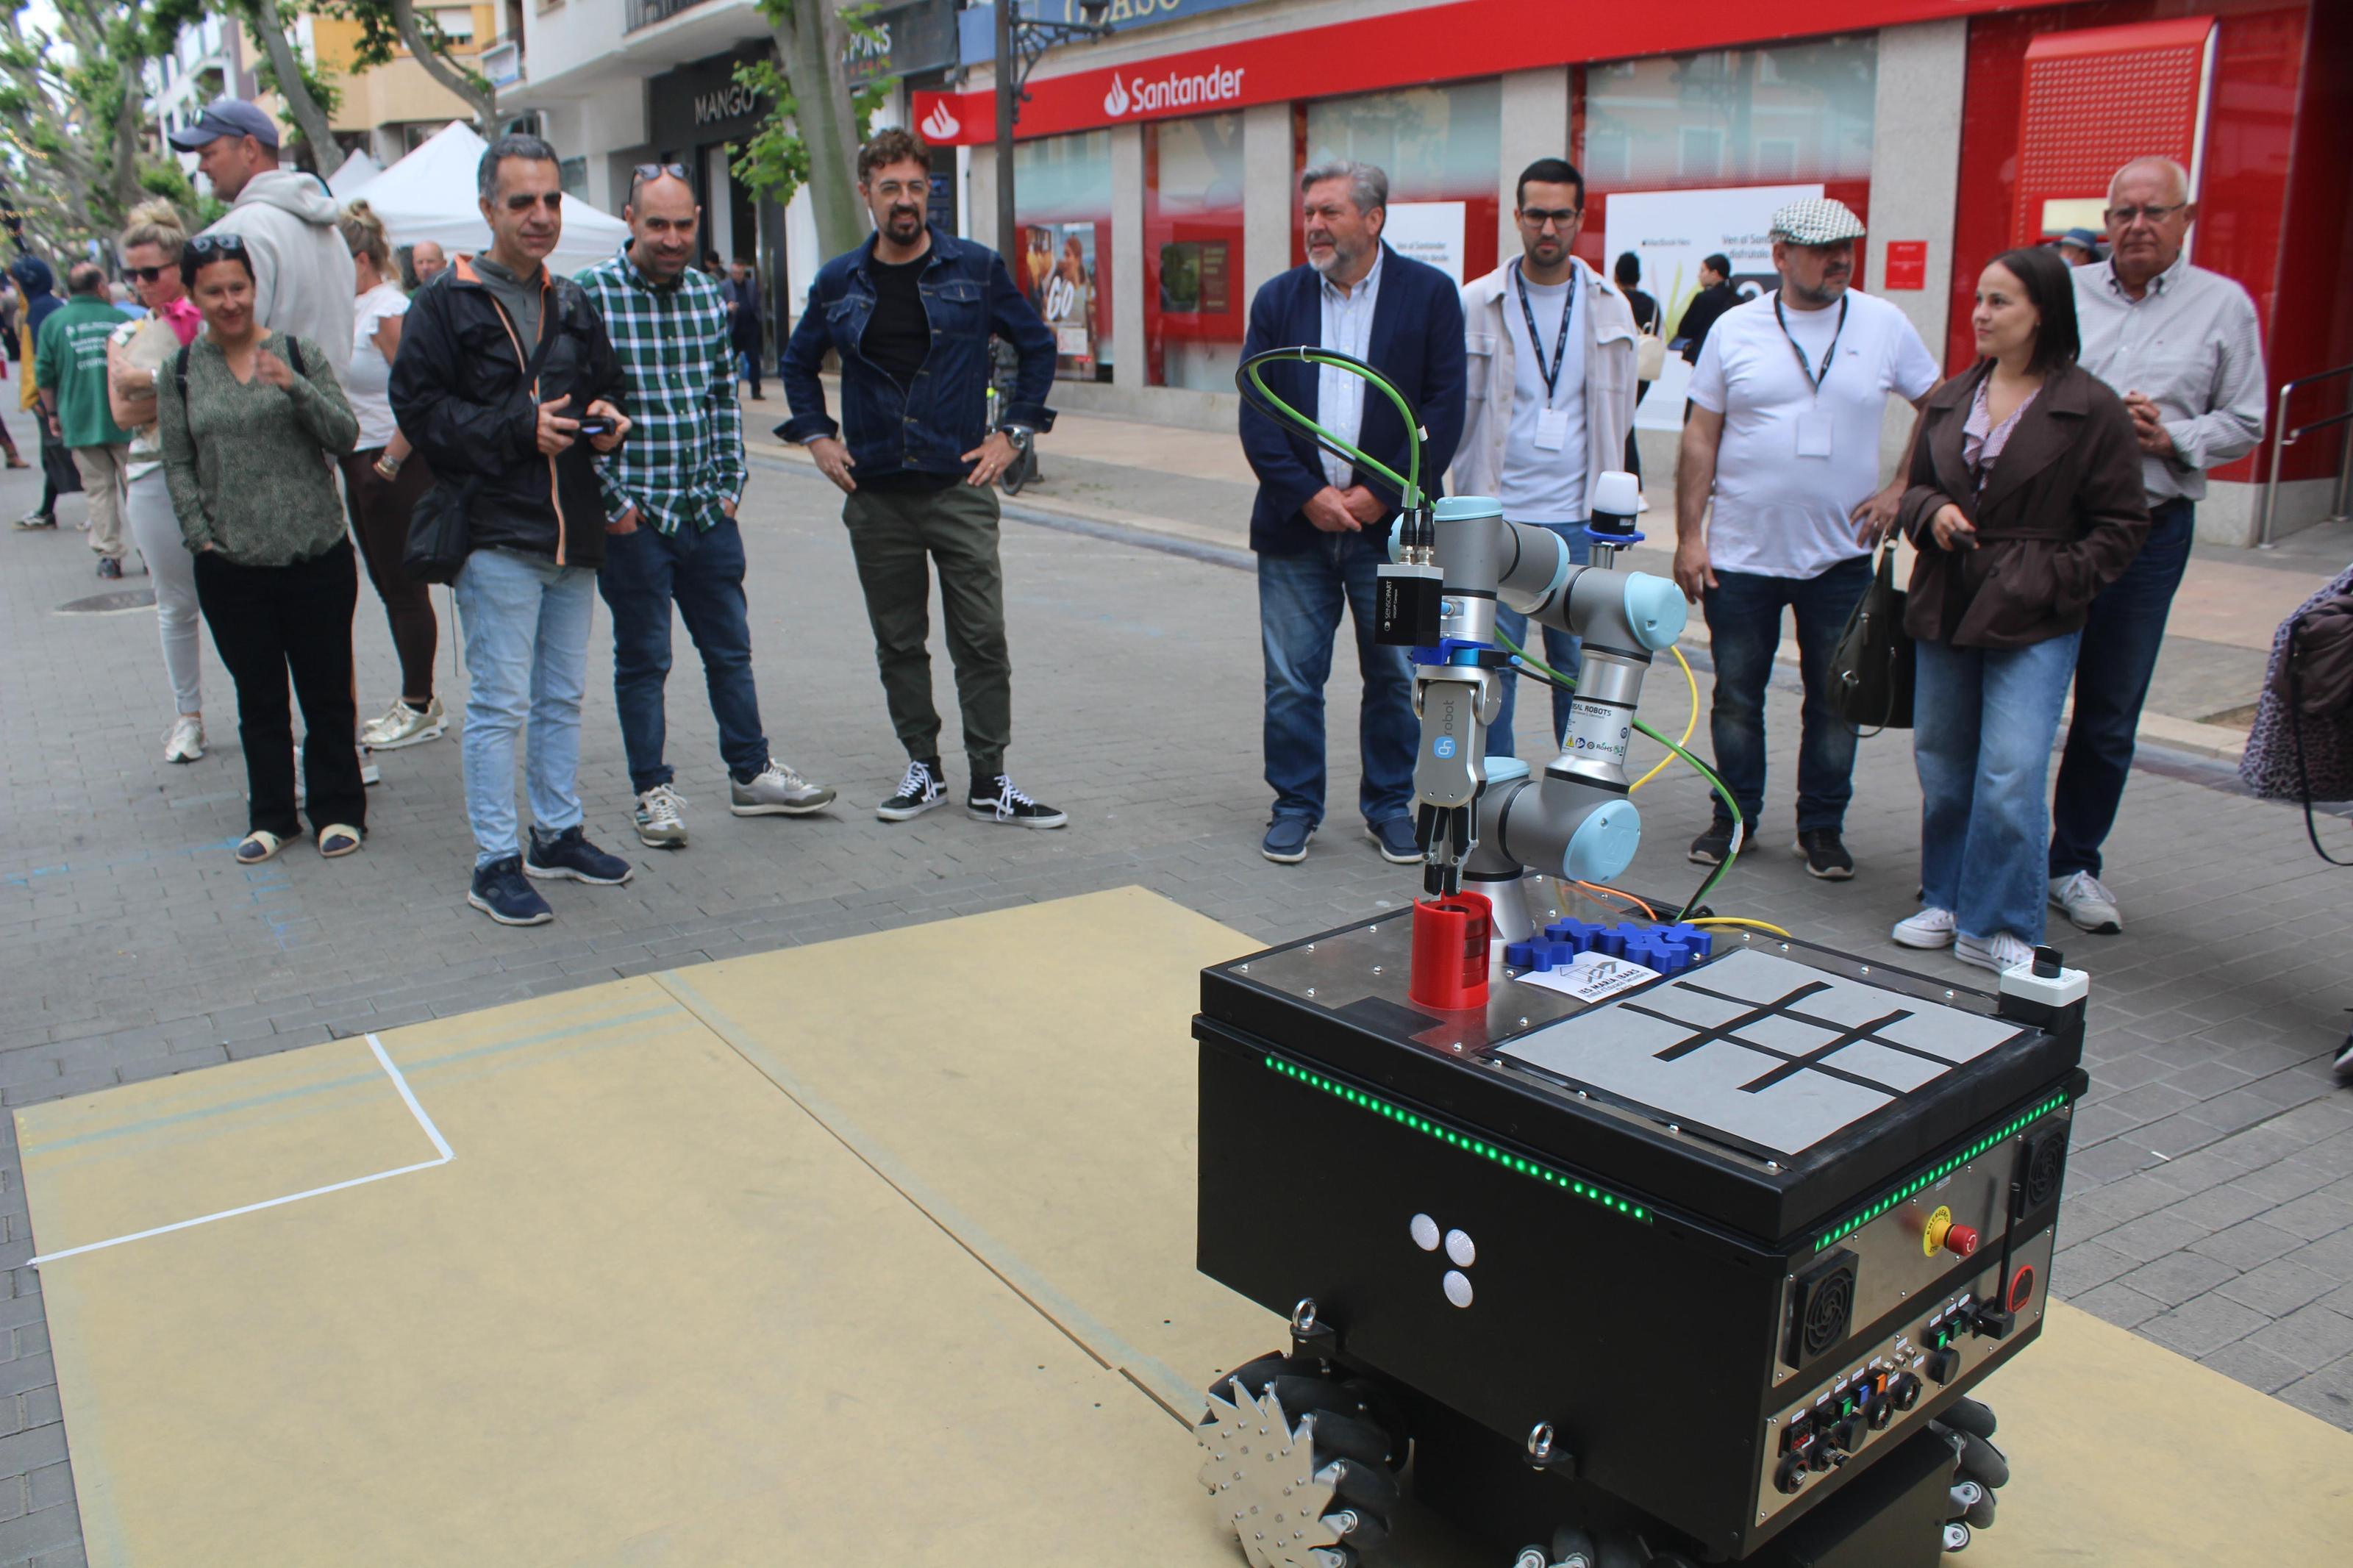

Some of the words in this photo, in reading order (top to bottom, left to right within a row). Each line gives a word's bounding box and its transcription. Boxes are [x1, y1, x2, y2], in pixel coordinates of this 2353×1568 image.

[694, 82, 754, 125] MANGO
[1132, 64, 1245, 112] Santander
[1046, 276, 1075, 321] GO
[1442, 700, 1454, 735] robot
[1585, 705, 1612, 717] ROBOTS
